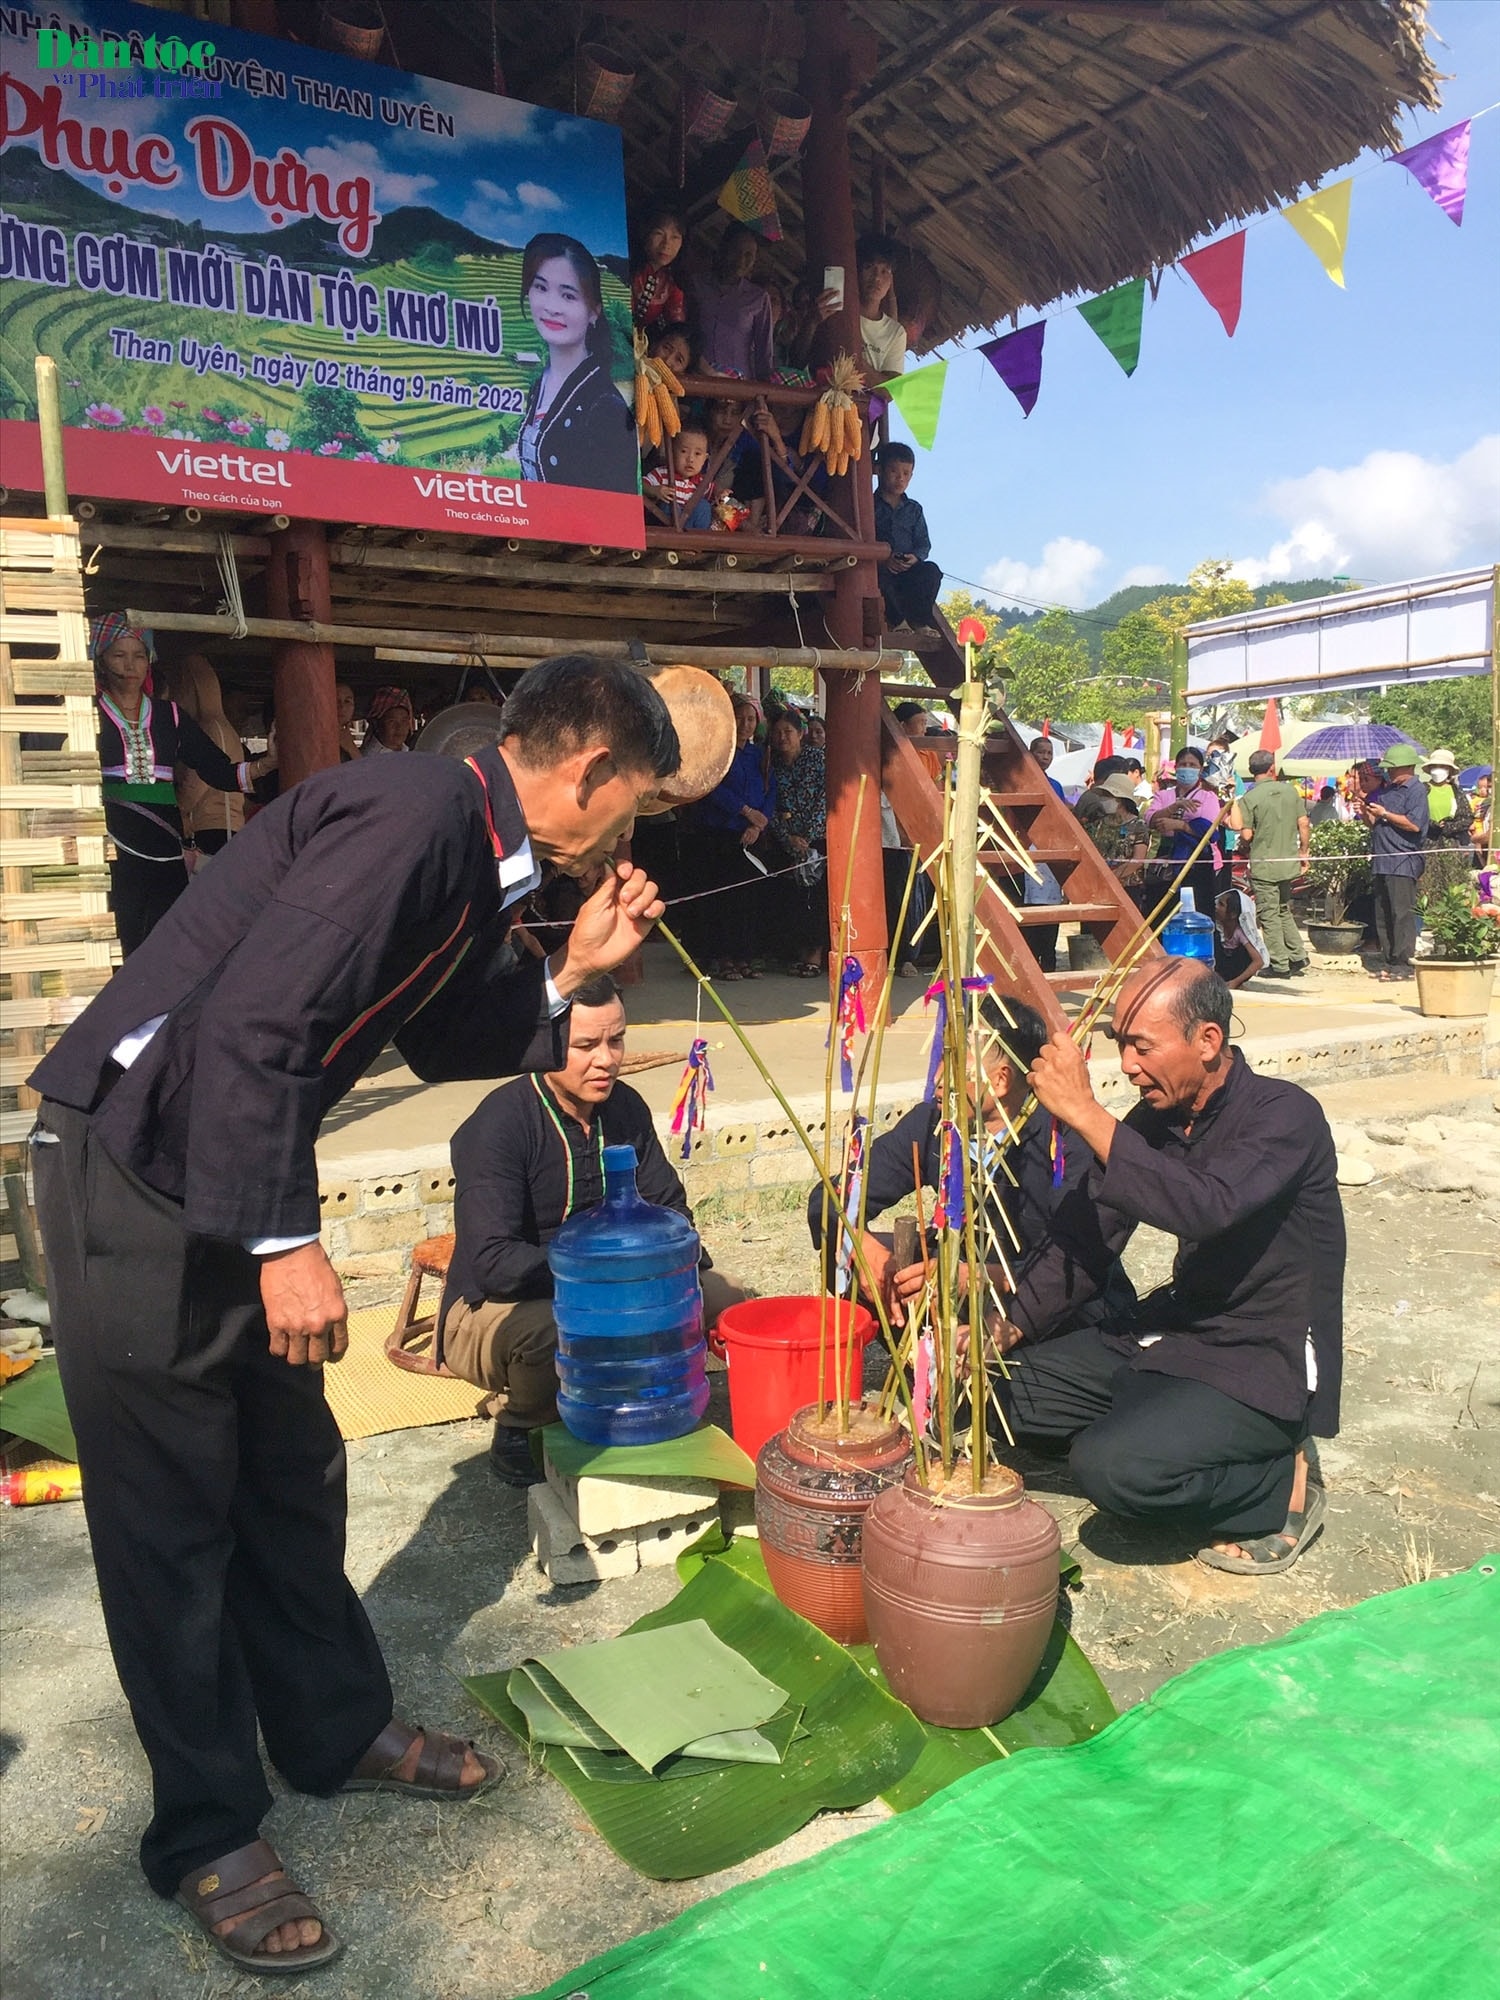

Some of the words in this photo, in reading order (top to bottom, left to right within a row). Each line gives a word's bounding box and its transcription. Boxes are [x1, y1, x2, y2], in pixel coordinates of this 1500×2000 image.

[294, 78, 372, 117] THAN
[381, 99, 455, 137] UYÊN
[0, 71, 178, 193] Phục
[189, 120, 378, 252] Dựng
[77, 236, 159, 298] CƠM
[169, 247, 235, 310] MỚI
[244, 258, 313, 323] DÂN
[320, 271, 379, 340] TỘC
[388, 289, 448, 345] KHƠ
[455, 298, 501, 354] MÚ
[112, 330, 171, 362] Than
[181, 340, 245, 378] Uyên,
[253, 354, 308, 387] ngày
[314, 360, 339, 387] 02
[346, 366, 405, 401] tháng
[412, 375, 424, 398] 9
[430, 380, 472, 405] năm
[478, 385, 524, 412] 2022
[156, 448, 292, 487] viettel
[413, 473, 528, 508] viettel
[181, 489, 210, 501] Theo
[213, 491, 238, 504] cách
[241, 493, 260, 506] của
[262, 495, 282, 509] bạn
[444, 508, 470, 520] Theo
[471, 511, 493, 522] cách
[494, 513, 511, 524] của
[512, 515, 529, 527] bạn
